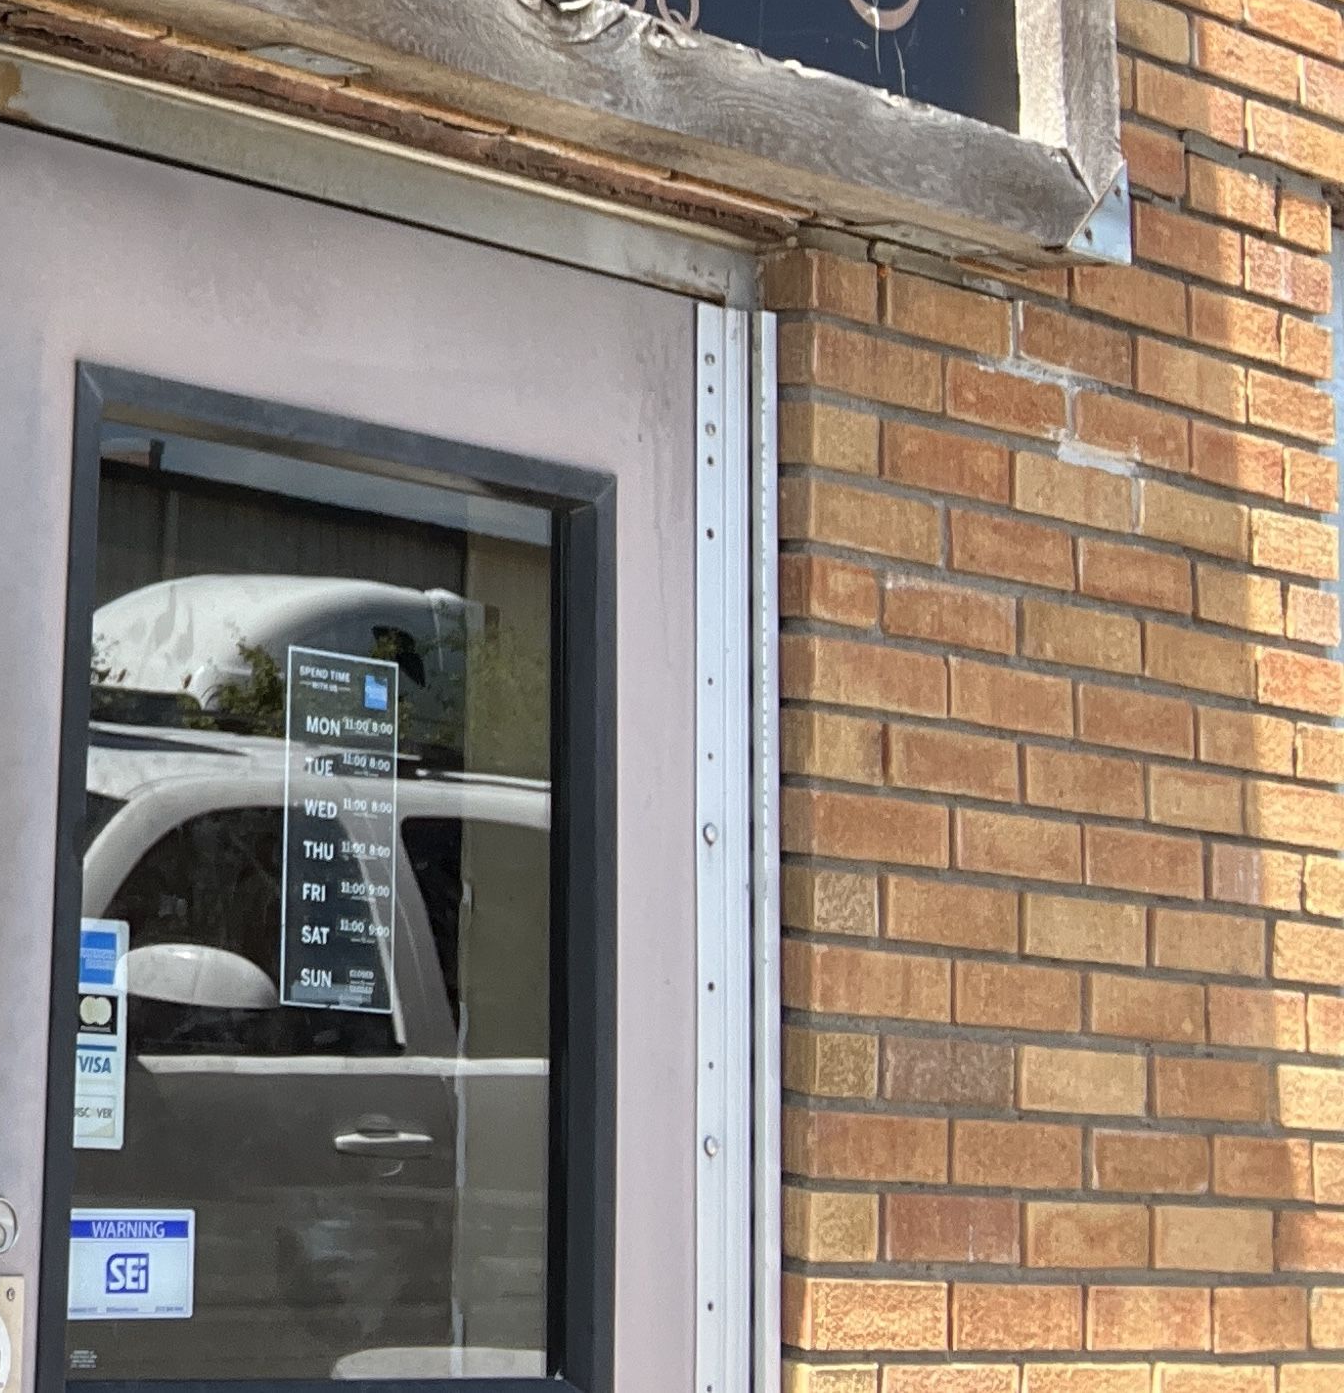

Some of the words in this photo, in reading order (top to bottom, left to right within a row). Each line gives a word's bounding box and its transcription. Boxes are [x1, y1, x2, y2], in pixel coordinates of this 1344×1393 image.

[299, 665, 329, 680] SPEND
[330, 669, 351, 683] TIME
[306, 715, 340, 737] MON
[304, 756, 334, 777] TUE
[304, 798, 337, 819] WED
[343, 797, 367, 811] 11:00
[303, 840, 334, 861] THU
[341, 841, 366, 854] 11:00
[302, 882, 326, 902] FRI
[340, 881, 365, 895] 11:00
[301, 924, 330, 945] SAT
[340, 919, 365, 933] 11:00
[300, 967, 332, 988] SUN
[78, 1055, 112, 1074] VISA
[91, 1221, 166, 1239] WARNING
